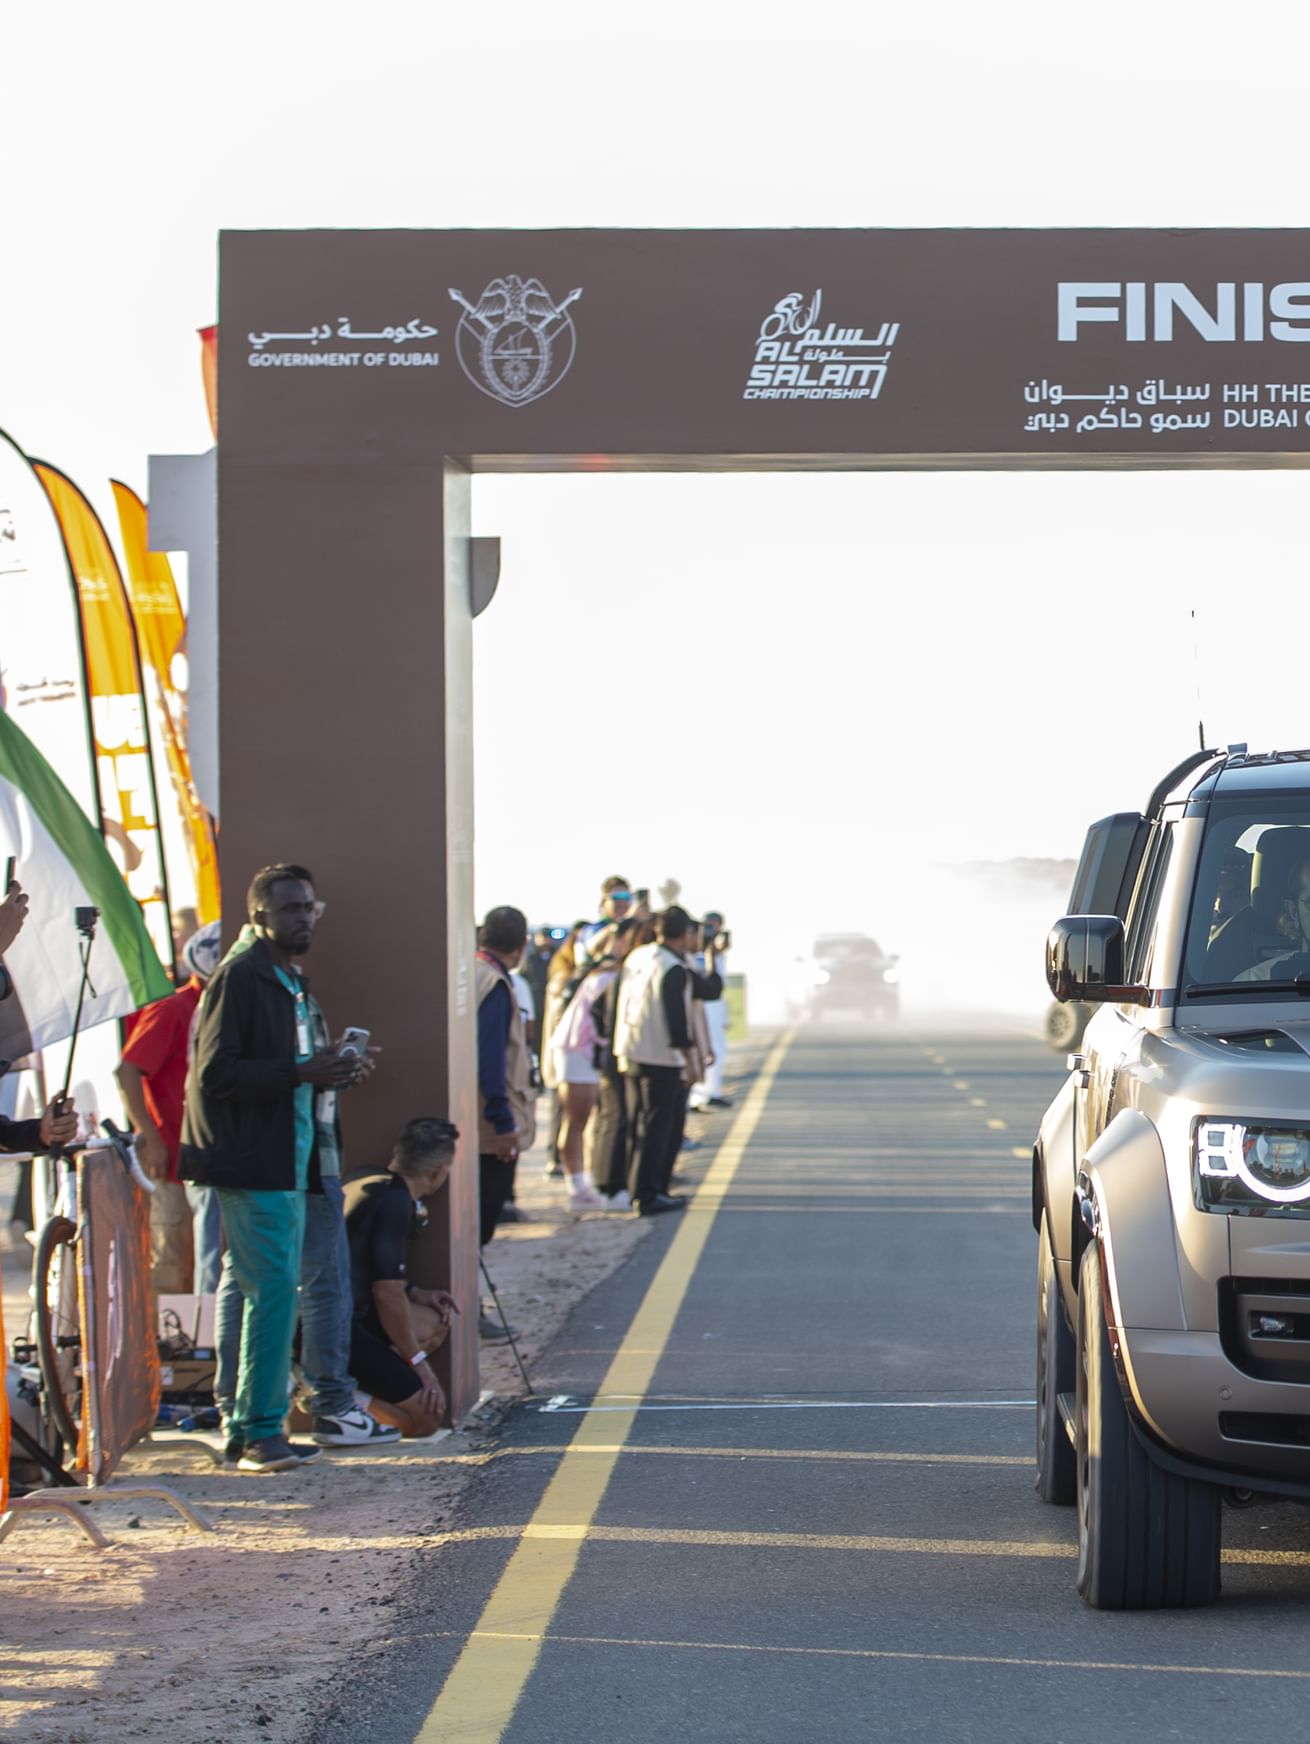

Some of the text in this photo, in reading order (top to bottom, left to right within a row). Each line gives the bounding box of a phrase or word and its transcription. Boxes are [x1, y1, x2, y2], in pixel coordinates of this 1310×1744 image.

[248, 317, 439, 350] حكومة دبي
[248, 353, 439, 367] GOVERNMENT OF DUBAI
[754, 341, 800, 362] AL
[746, 364, 887, 399] SALAM
[1023, 379, 1211, 405] سباق ديوان
[743, 388, 871, 399] CHAMPIONSHIP
[1223, 384, 1258, 403] HH
[1024, 407, 1211, 433] سمو حاكم دبي
[1223, 409, 1298, 428] DUBAI
